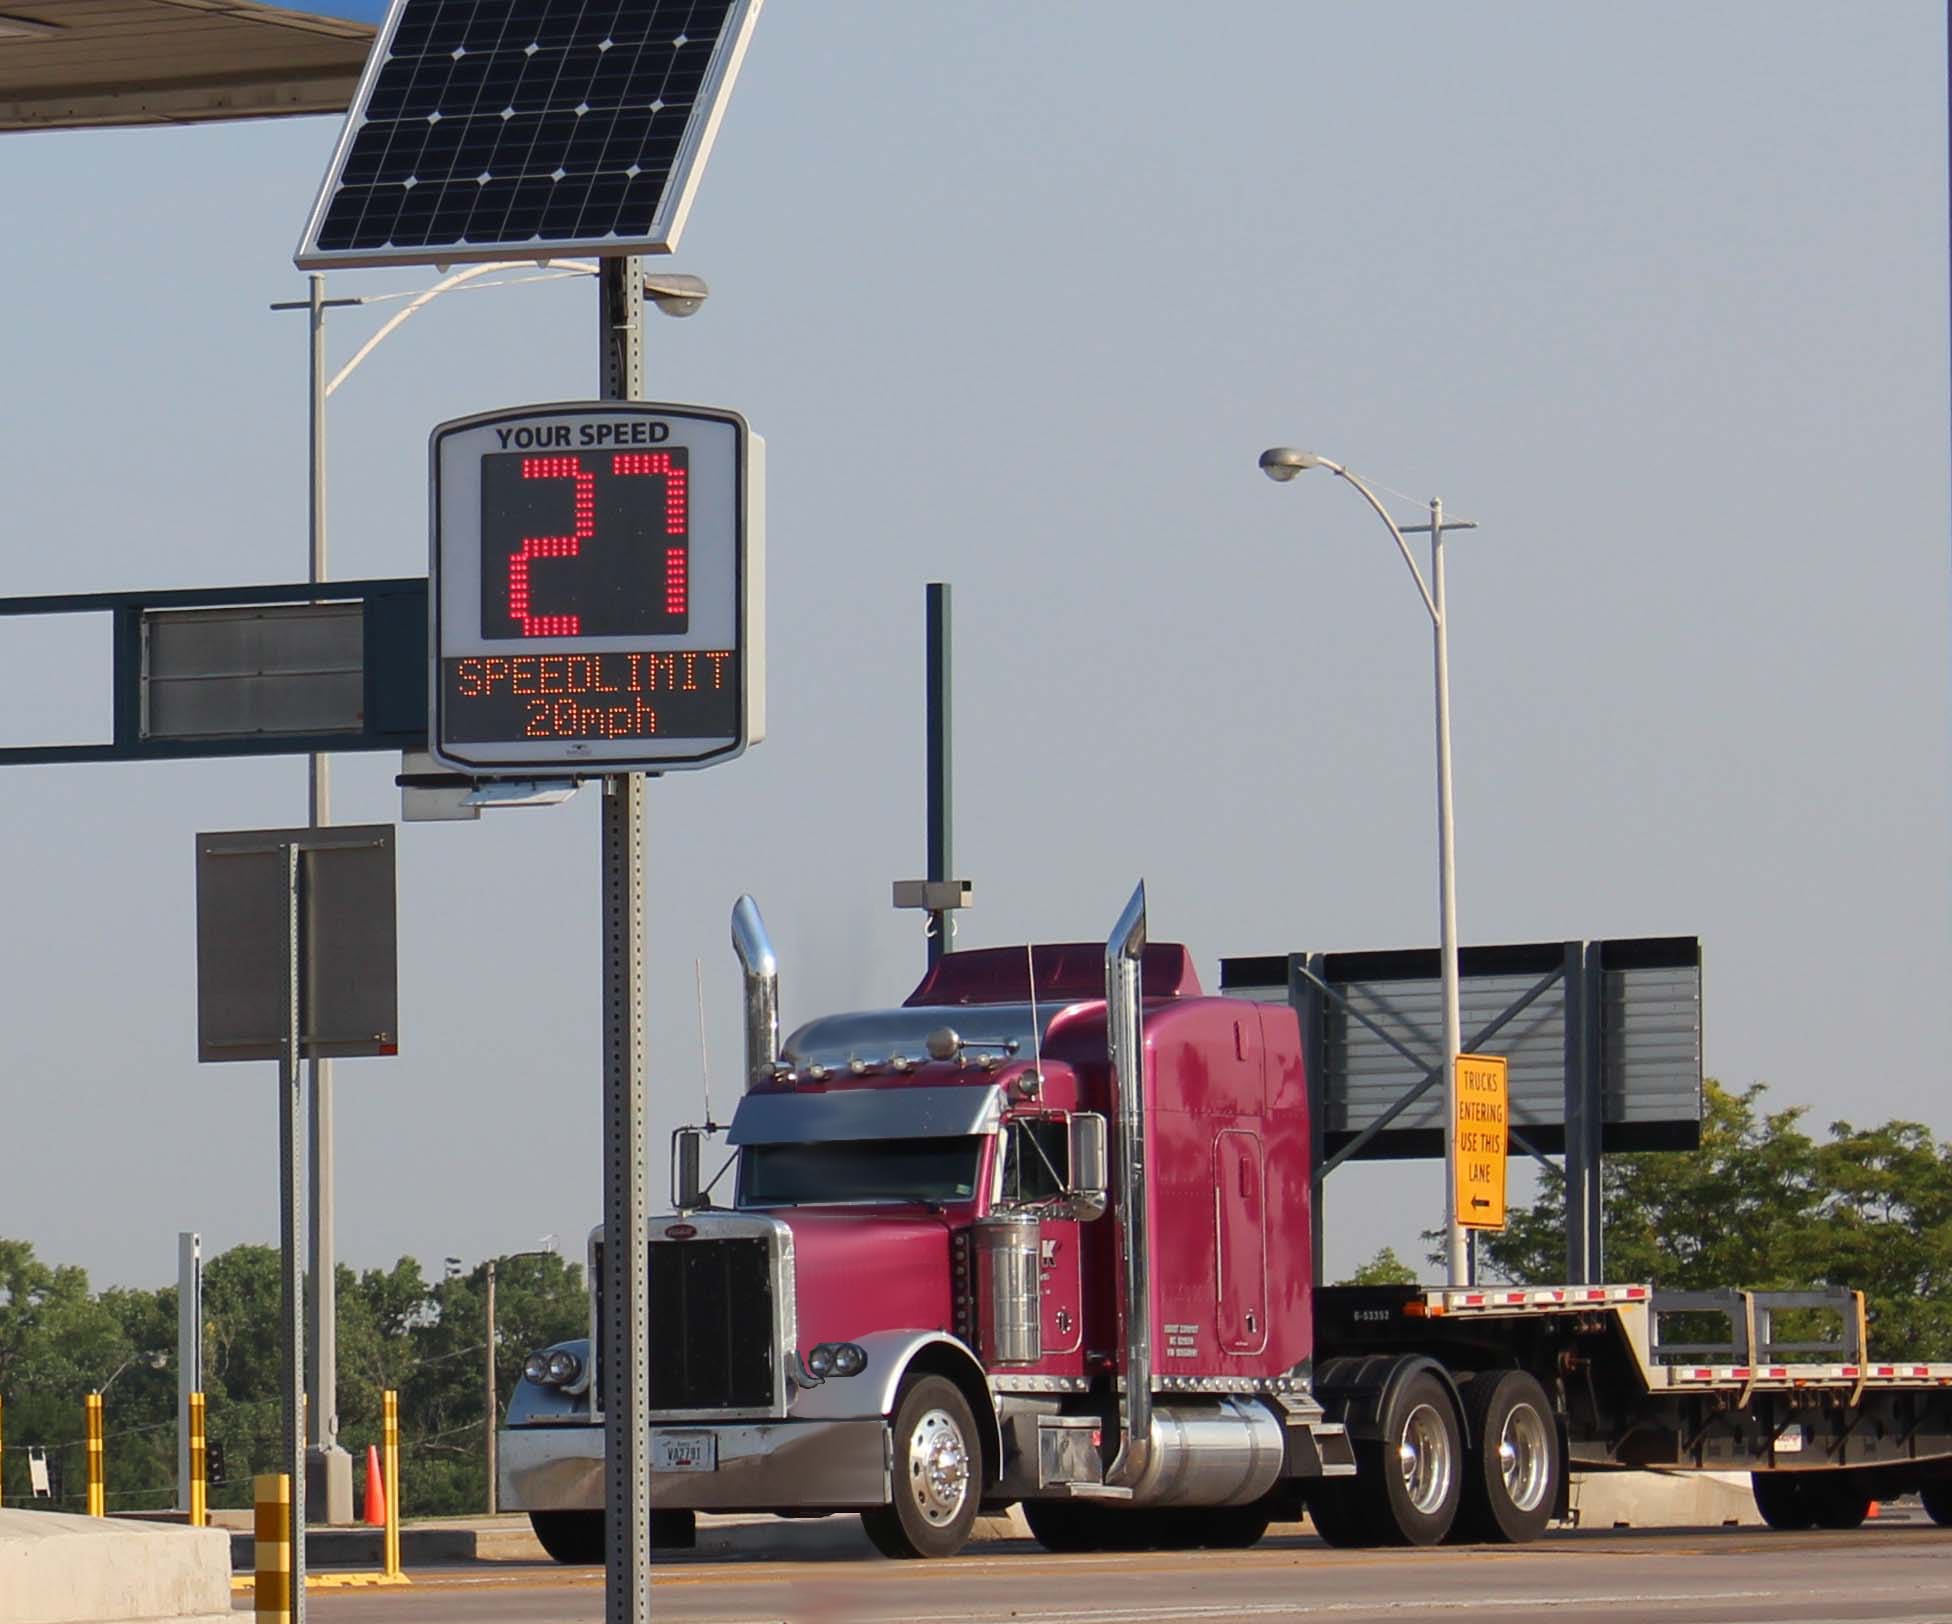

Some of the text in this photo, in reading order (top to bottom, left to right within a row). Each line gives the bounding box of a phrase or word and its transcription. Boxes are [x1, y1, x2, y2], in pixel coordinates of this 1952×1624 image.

[495, 422, 670, 449] YOUR SPEED
[509, 454, 686, 636] 27
[525, 697, 656, 738] 20mph
[1464, 1070, 1498, 1093] TRUCKS
[1460, 1101, 1503, 1123] ENTERING
[1460, 1133, 1500, 1154] USE THIS
[1469, 1163, 1491, 1183] LANE
